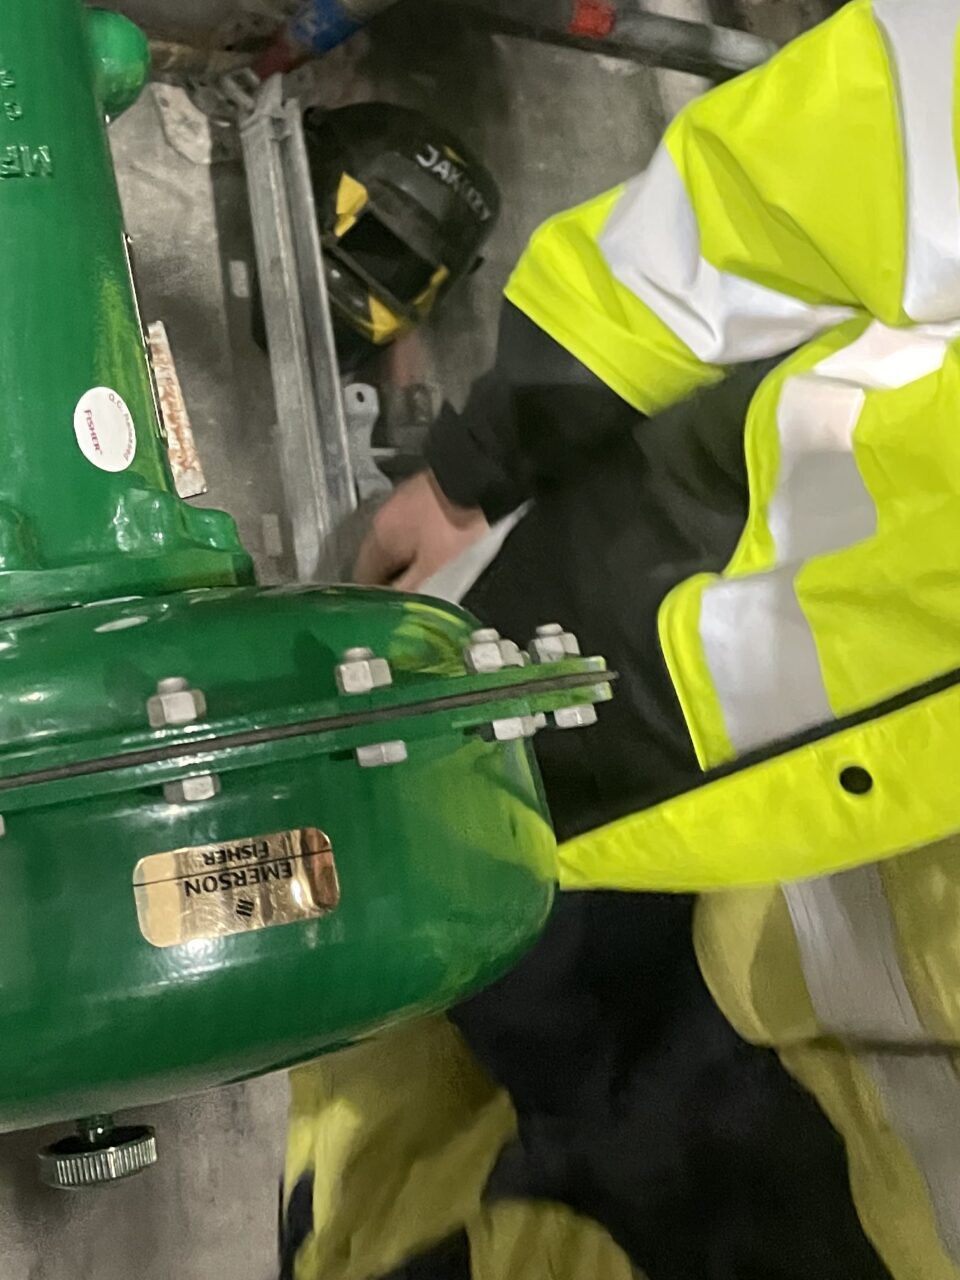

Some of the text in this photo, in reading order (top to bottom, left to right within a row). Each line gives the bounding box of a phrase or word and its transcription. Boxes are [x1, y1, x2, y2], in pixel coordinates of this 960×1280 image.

[84, 409, 101, 451] FISHER
[202, 841, 270, 866] FISHER
[184, 860, 294, 897] EMERSON
